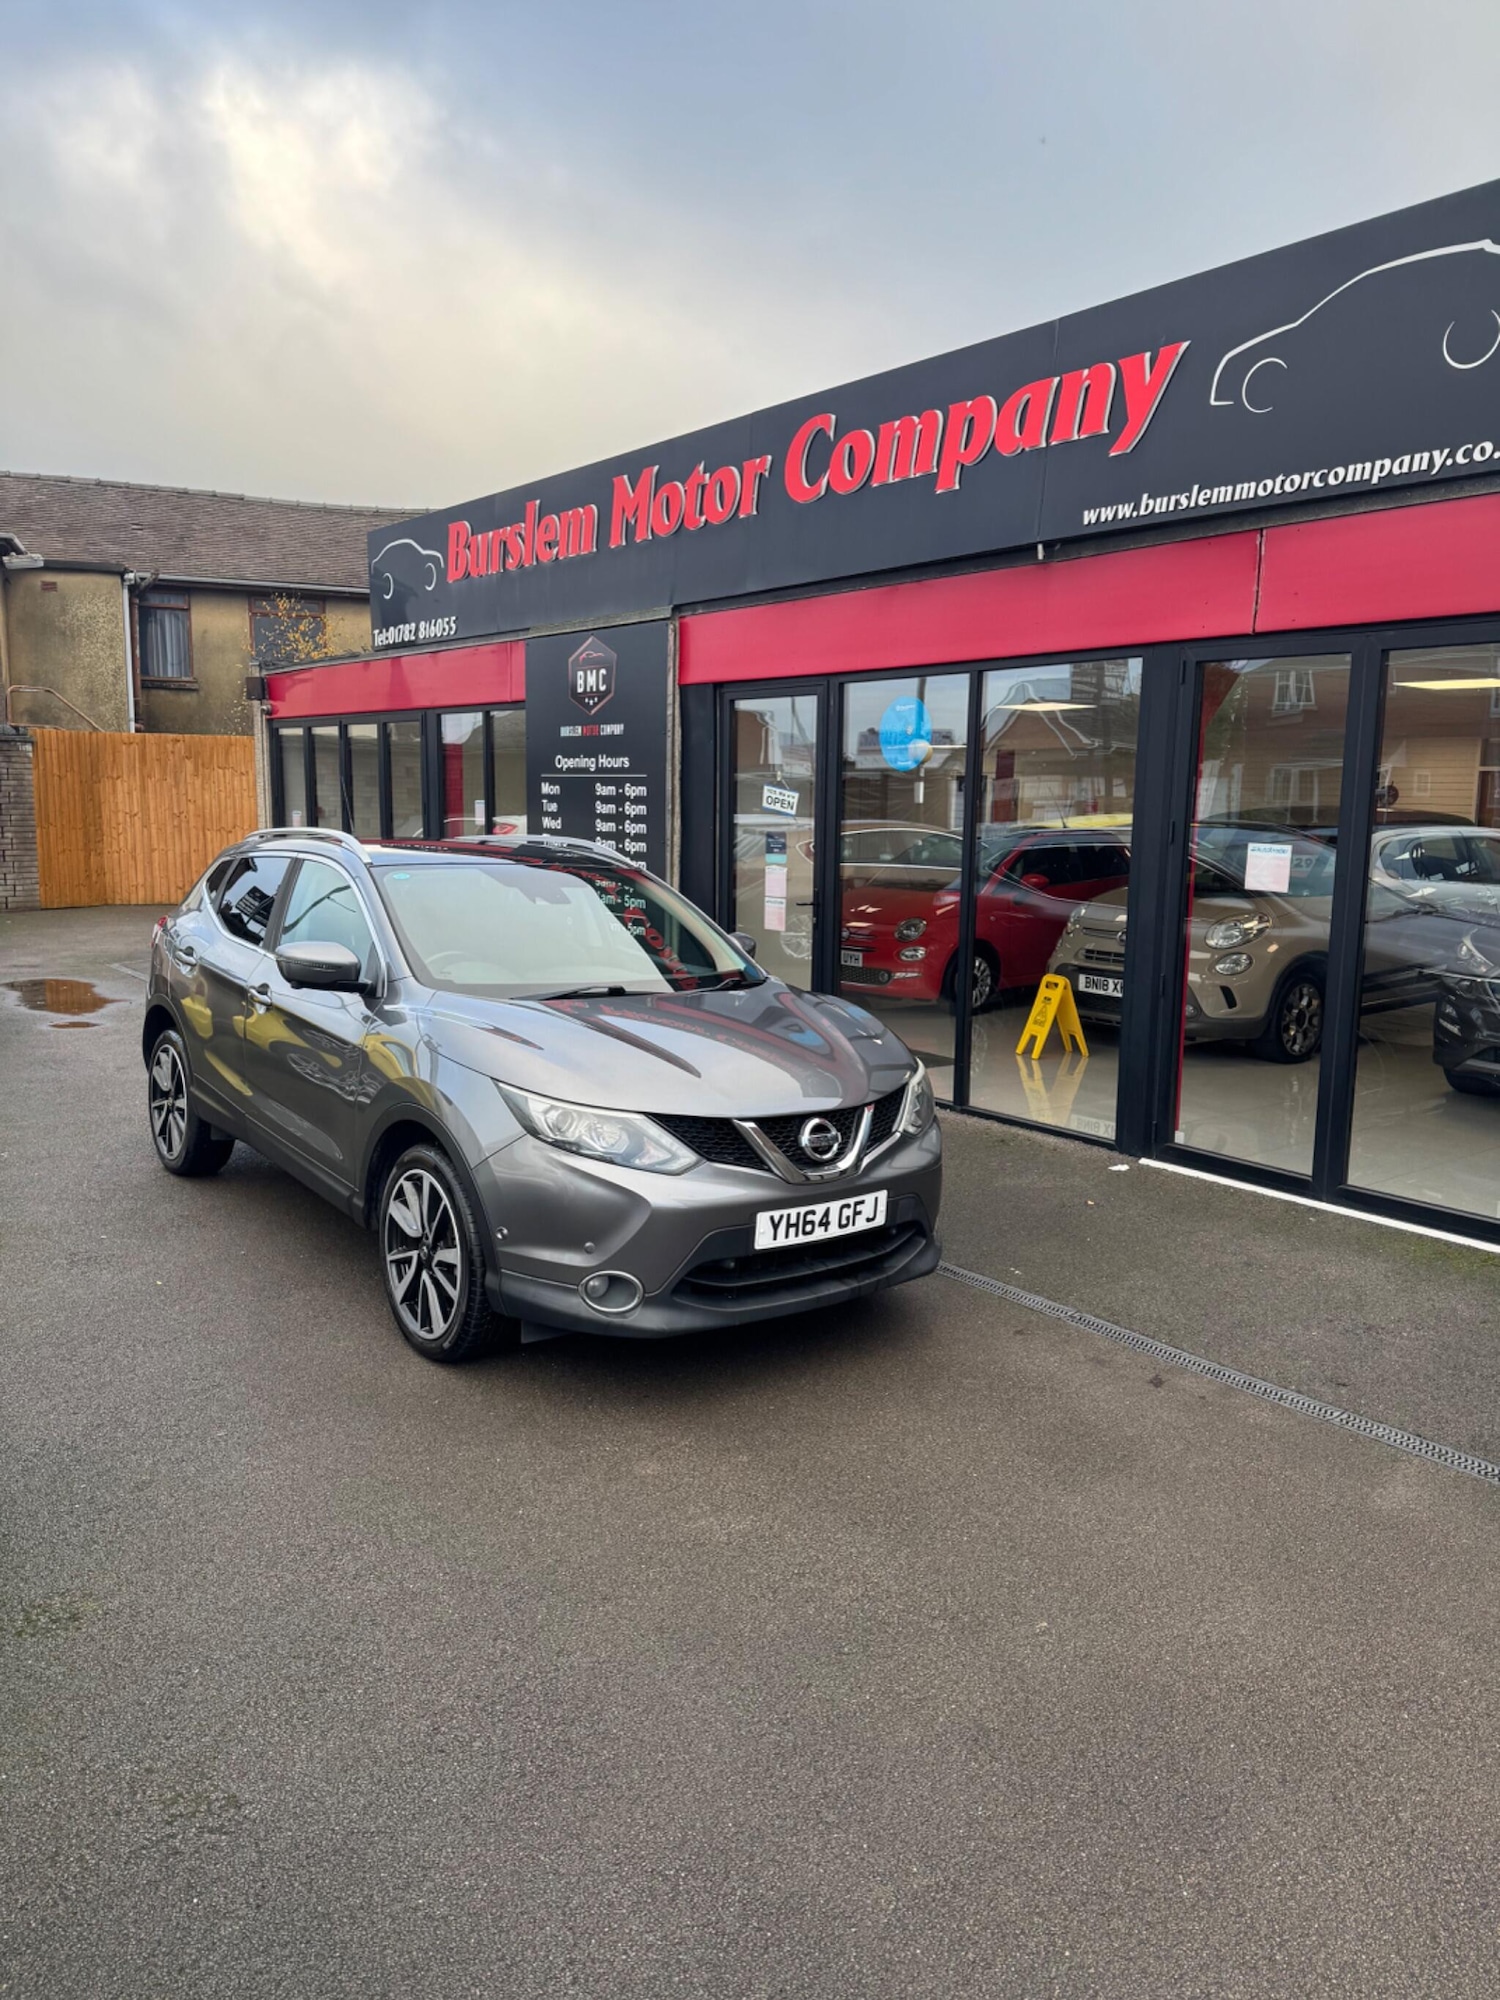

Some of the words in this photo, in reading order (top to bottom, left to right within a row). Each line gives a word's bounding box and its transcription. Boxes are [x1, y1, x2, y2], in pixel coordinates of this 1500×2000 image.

[446, 499, 598, 584] Burslem
[609, 454, 772, 549] Motor
[785, 340, 1191, 504] Company
[373, 622, 416, 647] Tel:01782
[418, 616, 457, 639] 816055
[576, 668, 607, 693] BMC
[554, 754, 596, 772] Opening
[598, 753, 630, 768] Hours
[541, 782, 561, 795] Mon
[595, 783, 616, 796] 9am
[624, 783, 647, 799] 6pm
[541, 800, 558, 812] Tue
[595, 801, 616, 814] 9am
[624, 801, 647, 818] 6pm
[766, 795, 795, 810] OPEN
[542, 817, 562, 829] Wed
[595, 819, 616, 832] 9am
[624, 820, 647, 836] 6pm
[624, 838, 647, 855] 6pm
[623, 895, 647, 911] 5pm
[769, 1206, 831, 1241] YH64
[838, 1196, 879, 1229] GFJ
